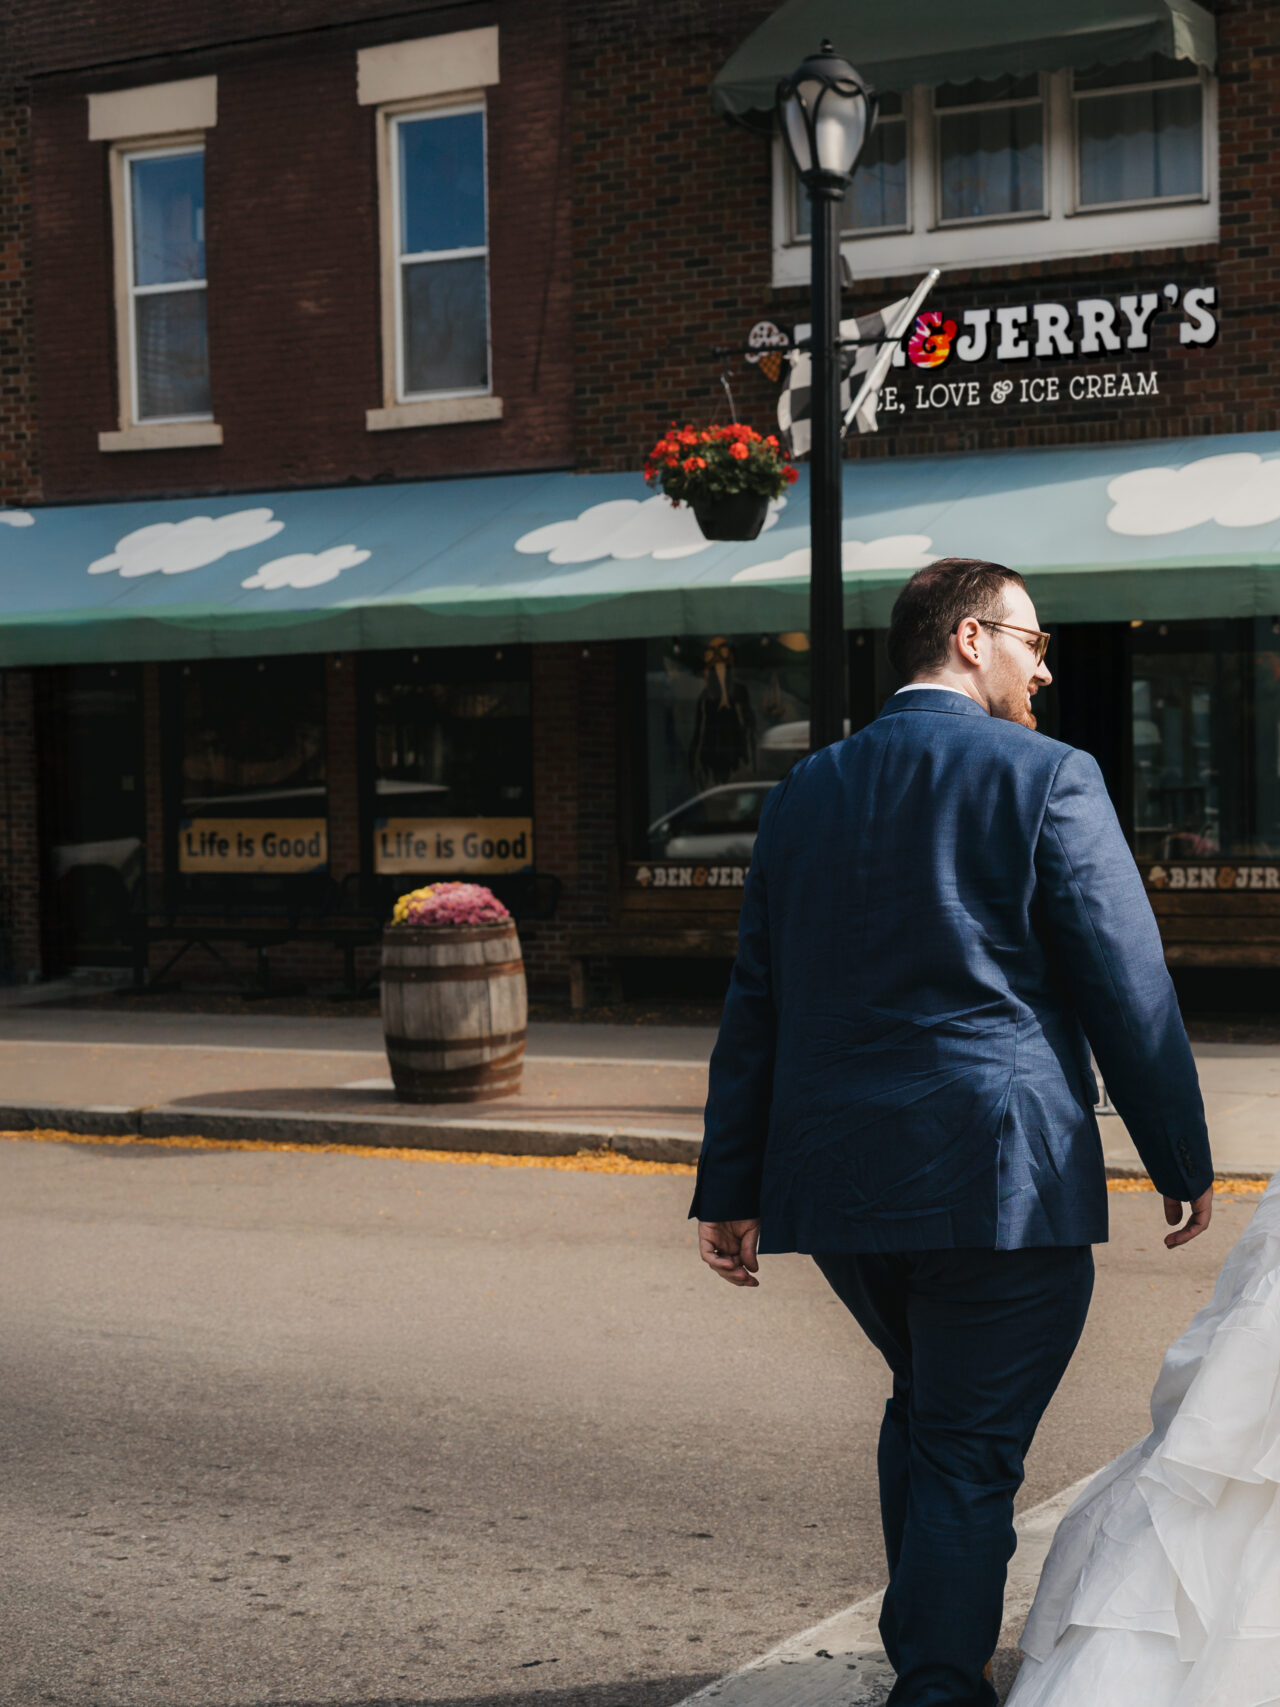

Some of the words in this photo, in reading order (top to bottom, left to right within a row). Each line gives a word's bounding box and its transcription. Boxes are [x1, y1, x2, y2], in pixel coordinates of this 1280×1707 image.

[915, 382, 981, 409] LOVE
[990, 380, 1013, 404] &
[1020, 377, 1060, 402] ICE
[1069, 371, 1160, 400] CREAM
[186, 831, 230, 858] Life
[238, 831, 255, 858] is
[262, 831, 321, 858] Good
[381, 832, 427, 859] Life
[435, 832, 454, 859] is
[463, 831, 526, 859] Good
[653, 866, 750, 887] BEN&JER
